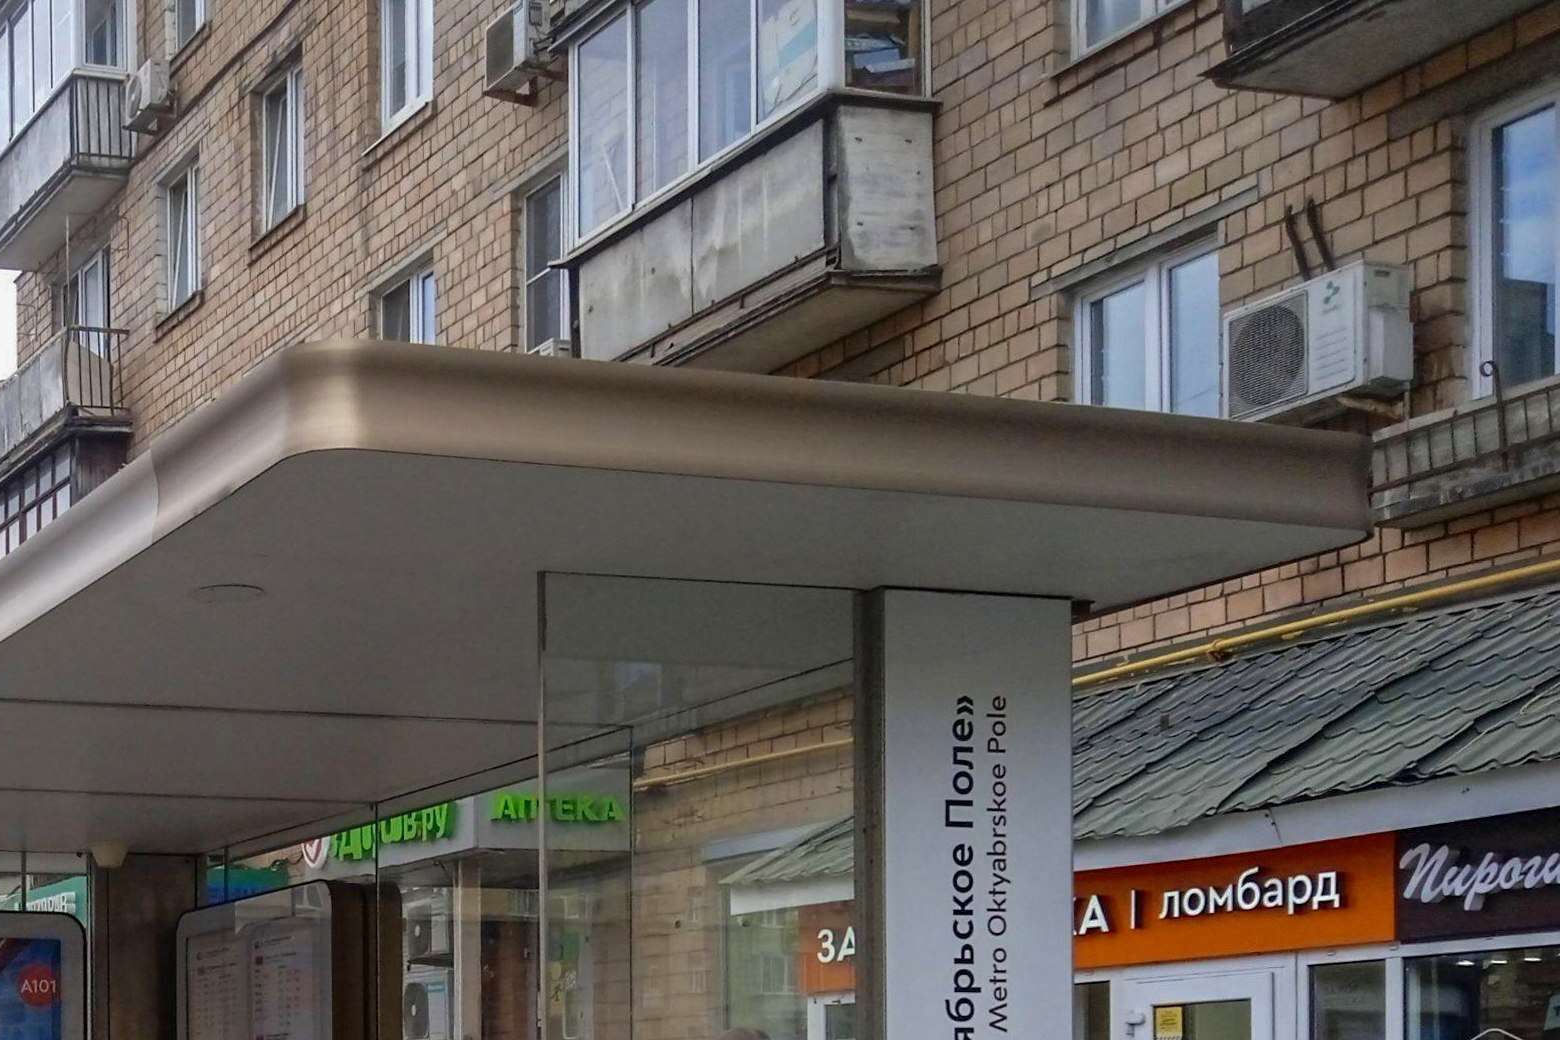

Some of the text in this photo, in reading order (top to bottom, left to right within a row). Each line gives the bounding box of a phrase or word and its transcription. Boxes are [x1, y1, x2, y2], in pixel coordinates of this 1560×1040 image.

[945, 695, 974, 828] Поле»
[491, 795, 625, 822] АПЕКА
[986, 695, 1011, 1033] Metro Oktyabrskoe Pole
[1158, 866, 1340, 919] ломбард
